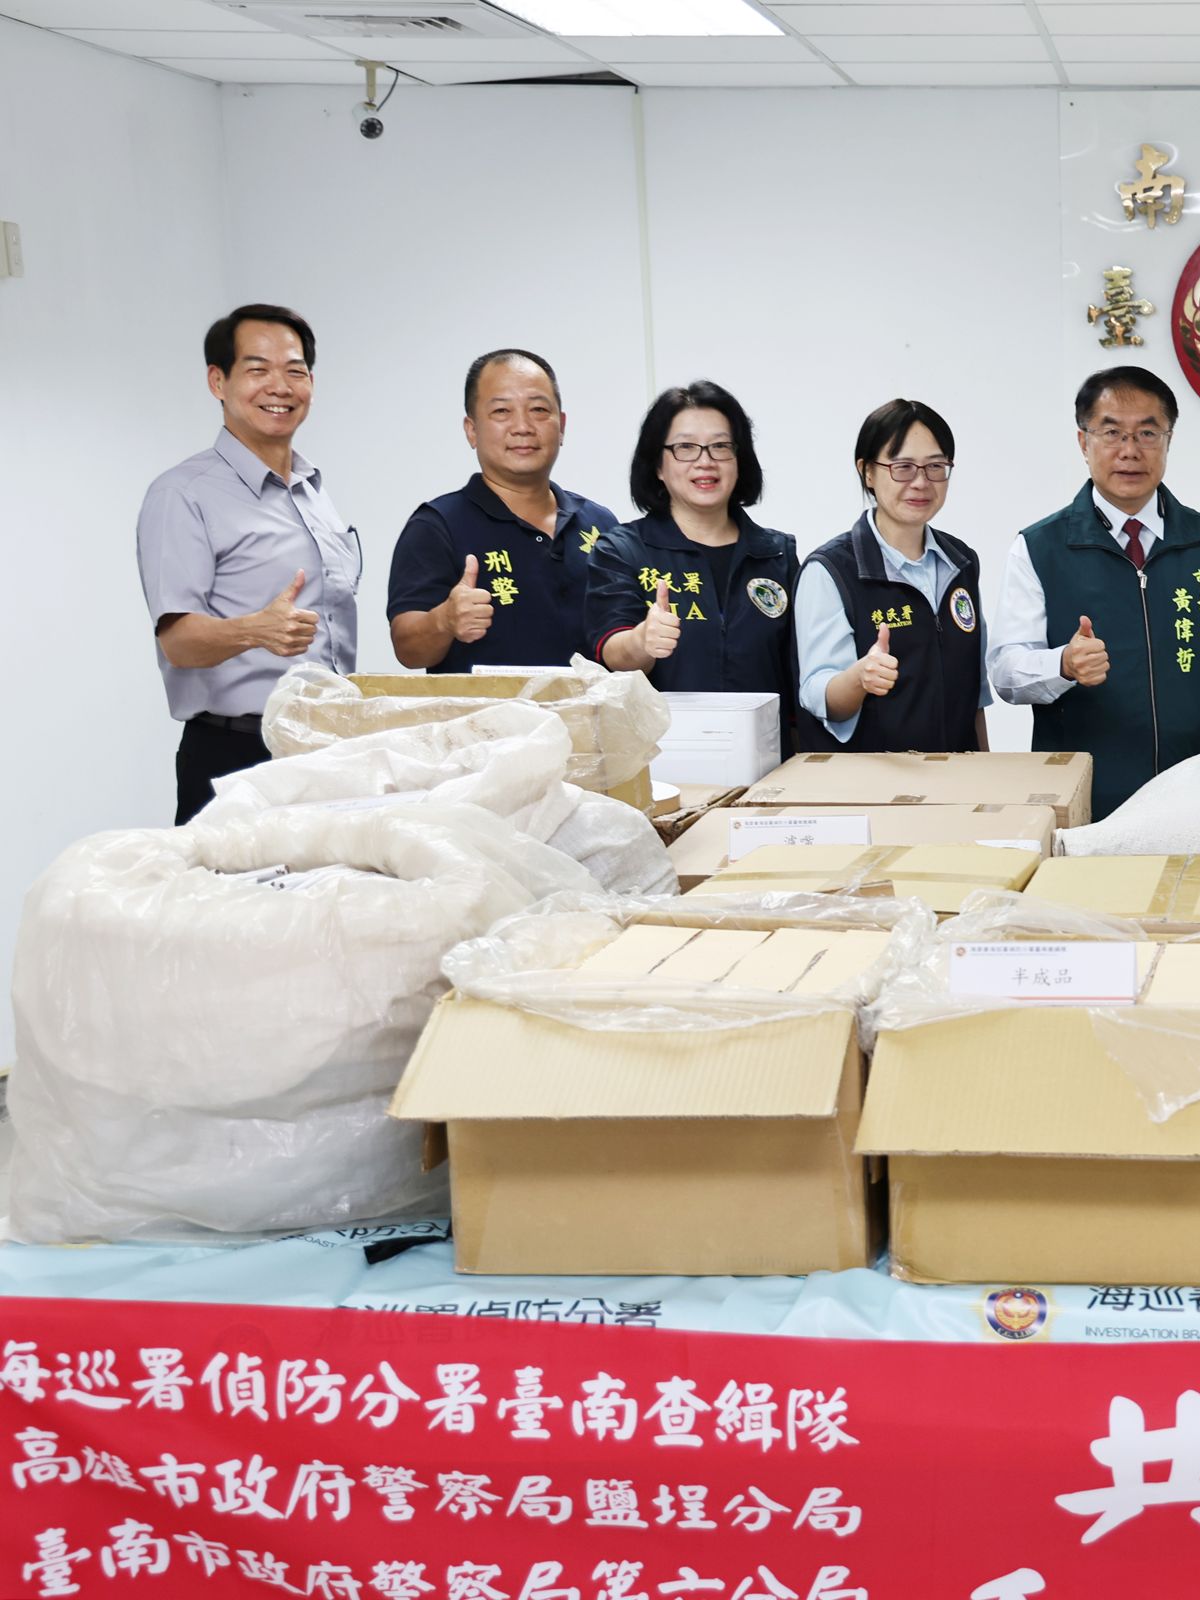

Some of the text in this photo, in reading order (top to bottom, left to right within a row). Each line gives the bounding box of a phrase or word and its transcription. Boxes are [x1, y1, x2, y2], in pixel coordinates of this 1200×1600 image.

[484, 549, 519, 606] 刑警
[645, 600, 707, 620] IA
[871, 604, 913, 624] 移民署
[1172, 588, 1195, 673] 黃偉哲
[1012, 967, 1073, 987] 半成品
[1085, 1326, 1180, 1340] INVESTIGATION
[0, 1339, 861, 1454] 海巡署偵防分署臺南查緝隊
[13, 1427, 863, 1537] 高雄市政府警察局鹽埕分局
